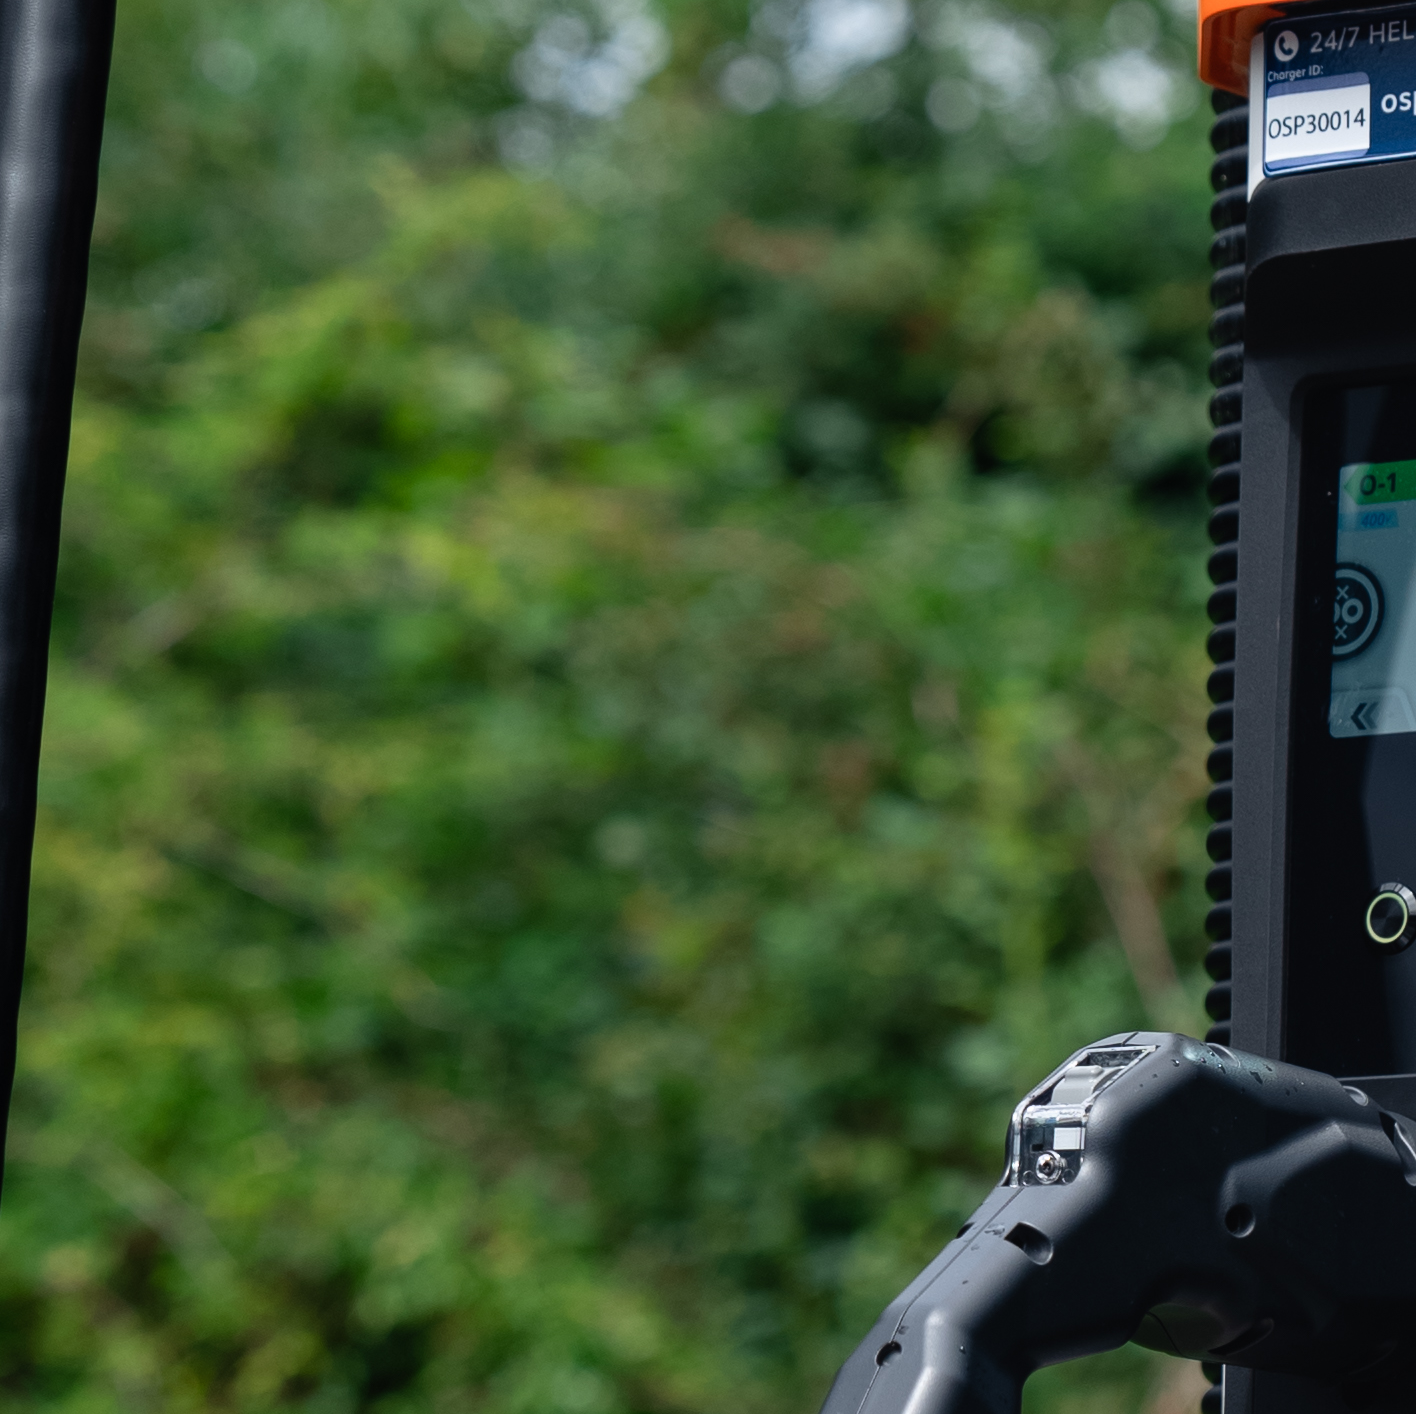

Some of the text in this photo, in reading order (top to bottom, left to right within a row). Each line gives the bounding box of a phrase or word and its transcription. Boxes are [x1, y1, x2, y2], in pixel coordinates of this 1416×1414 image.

[1310, 27, 1360, 53] 24/7
[1267, 64, 1324, 83] Charger ID:
[1268, 107, 1367, 140] OSP30014
